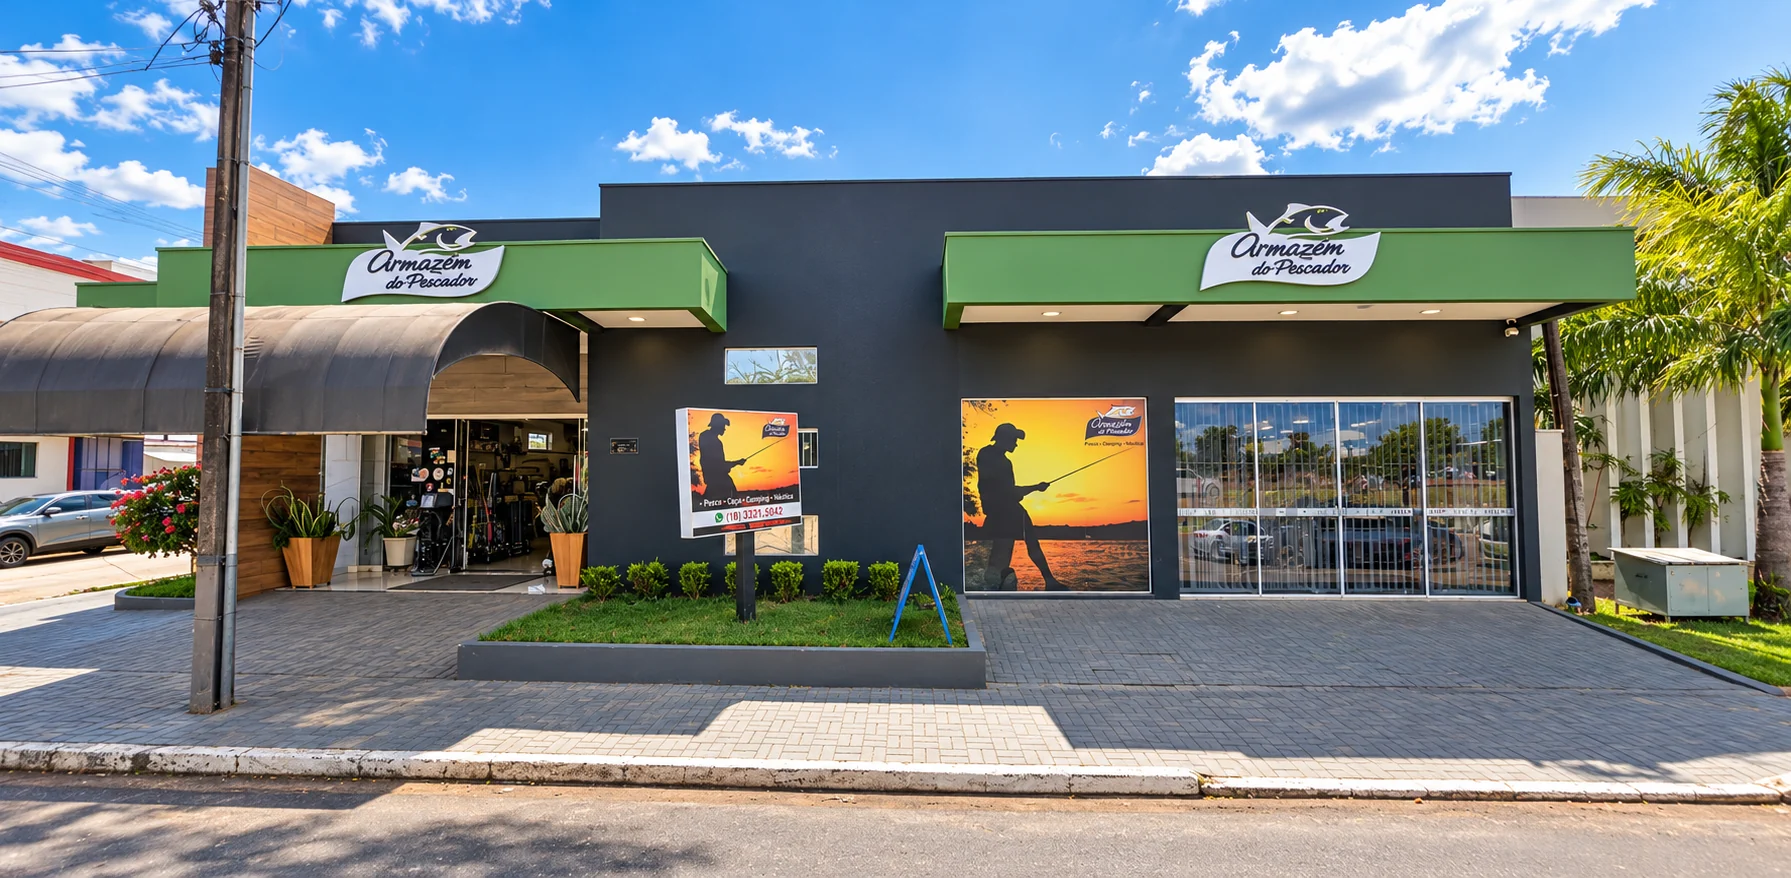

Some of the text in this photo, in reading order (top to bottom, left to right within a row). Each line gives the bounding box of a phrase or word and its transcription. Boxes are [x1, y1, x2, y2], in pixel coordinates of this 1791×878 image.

[1231, 233, 1345, 260] Armazém
[367, 250, 472, 274] Armazém
[1251, 259, 1351, 276] do Pescador
[385, 273, 478, 290] do Pescador
